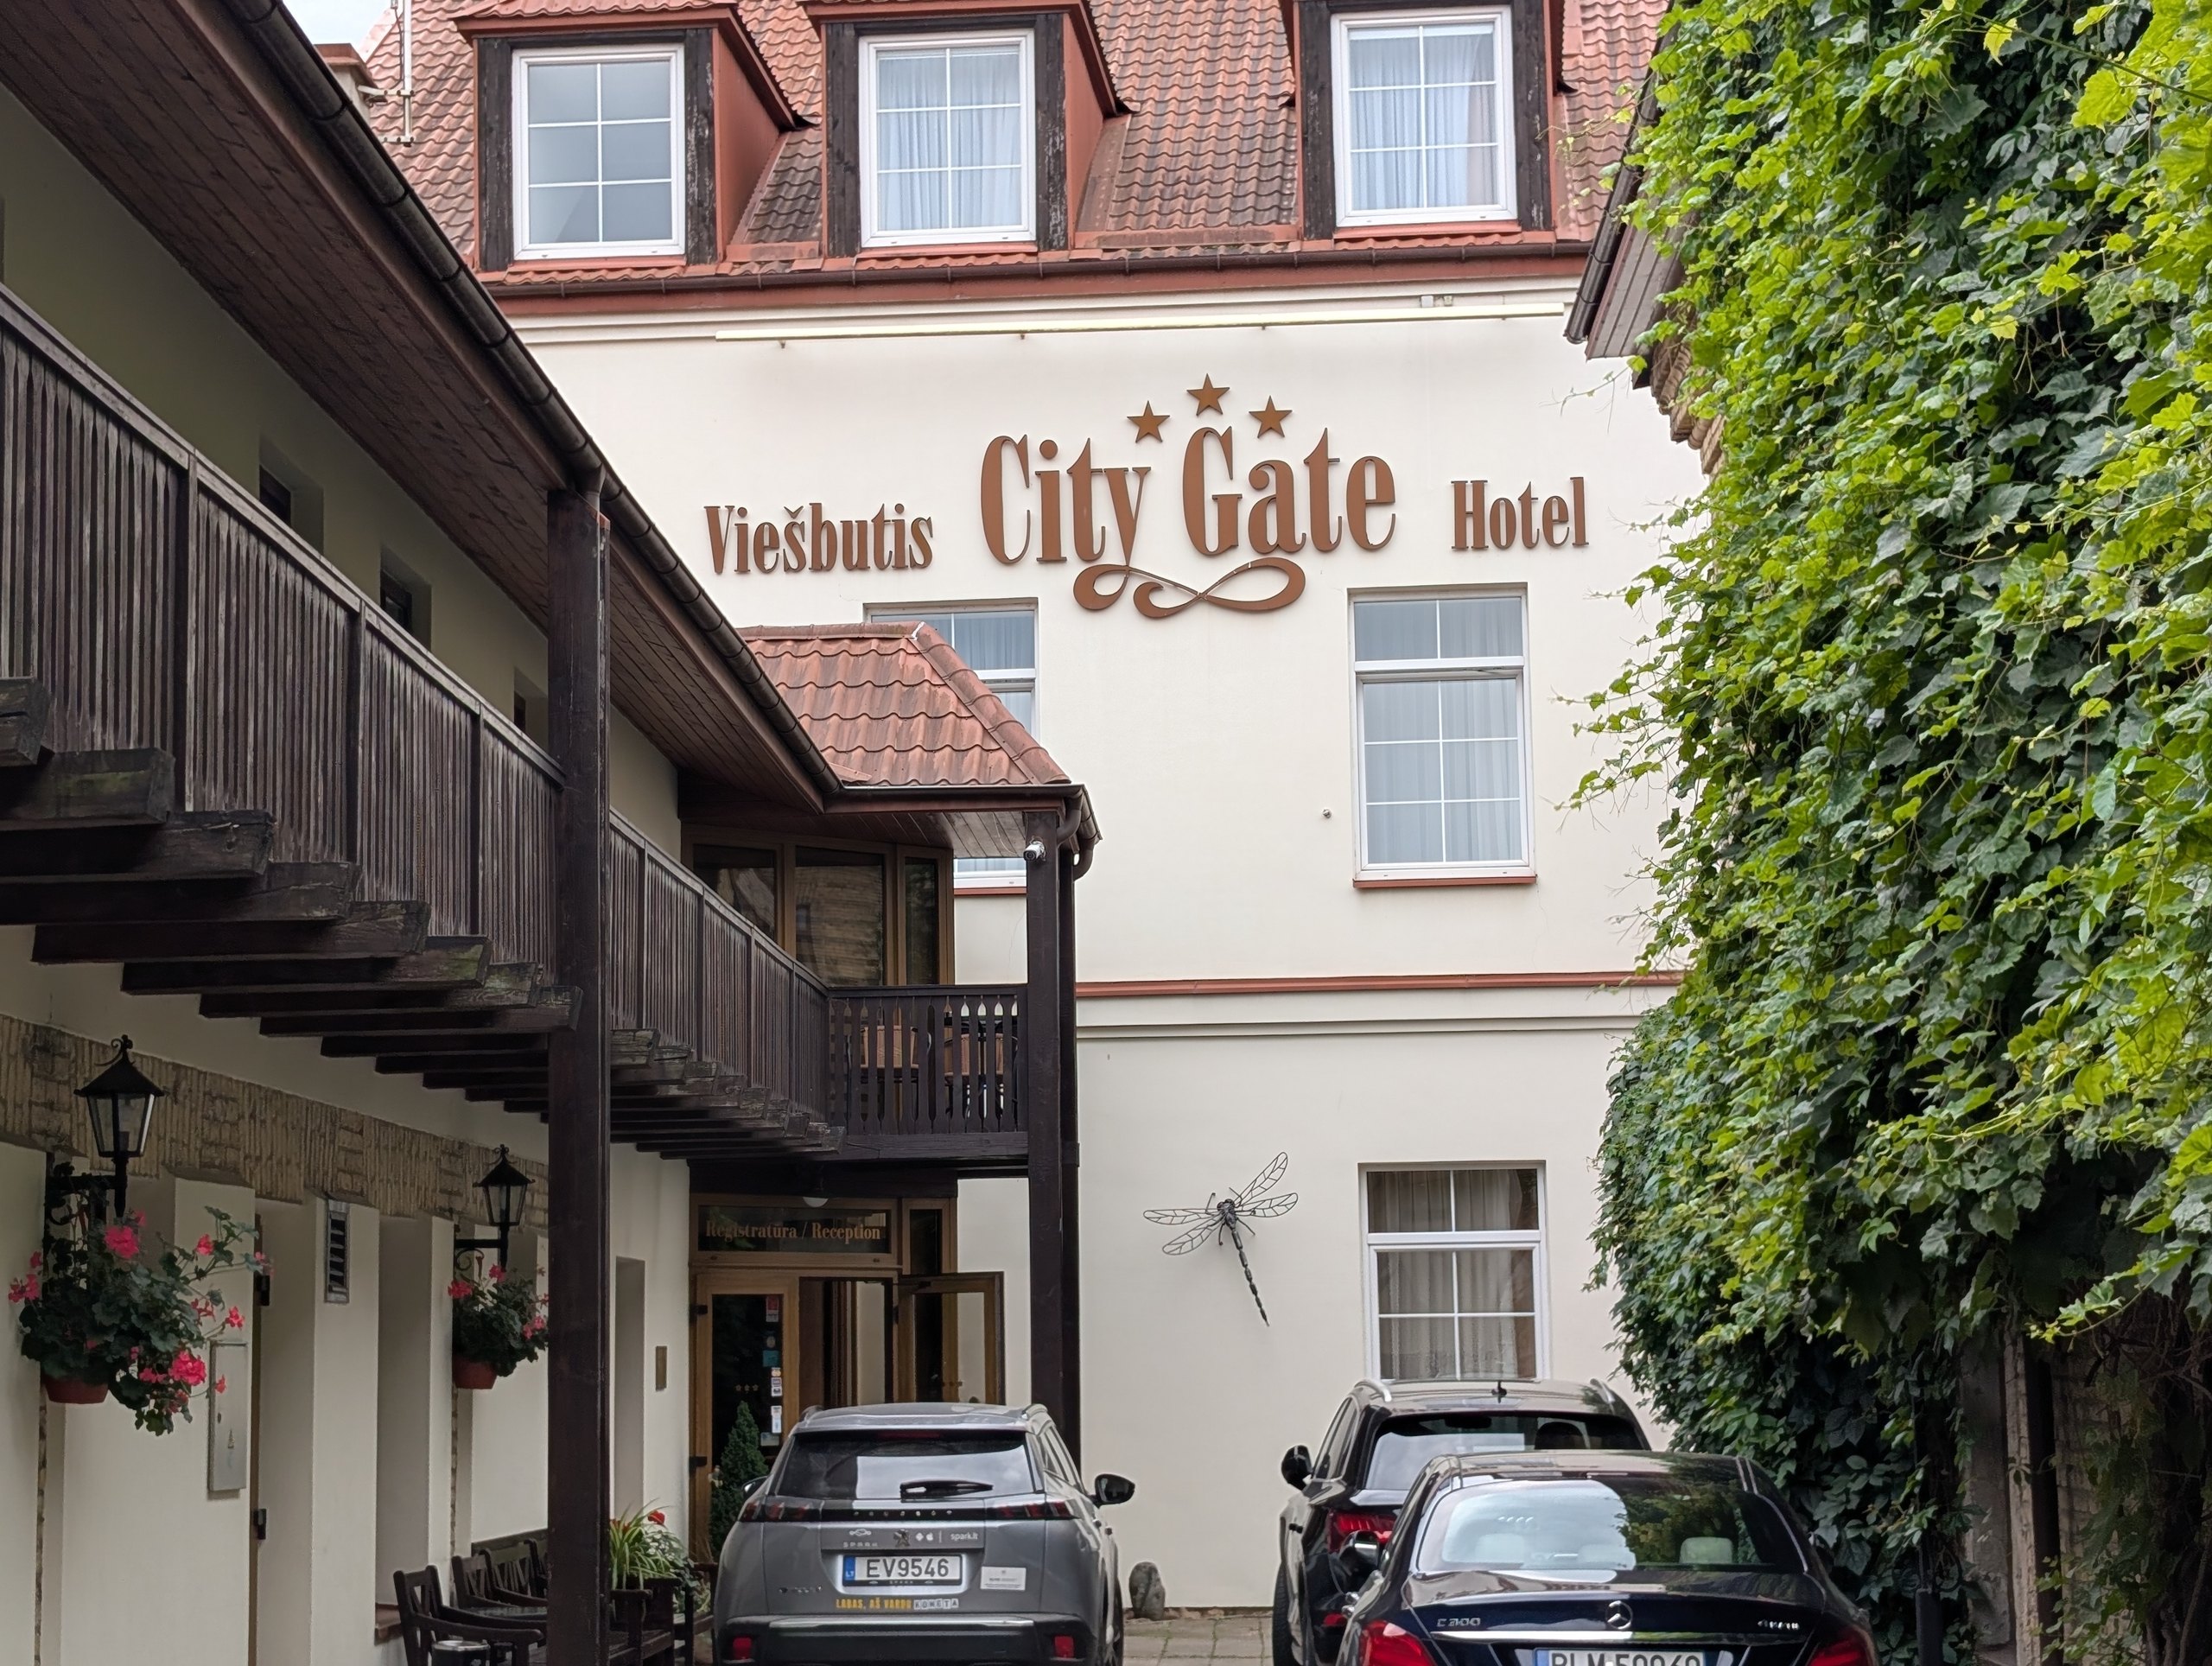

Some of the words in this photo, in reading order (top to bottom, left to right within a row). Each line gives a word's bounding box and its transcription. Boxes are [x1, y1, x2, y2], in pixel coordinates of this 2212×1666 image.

[704, 501, 933, 574] Viešbutis
[981, 435, 1152, 568] City
[1182, 426, 1395, 558] Gate
[1452, 477, 1589, 553] Hotel
[812, 1222, 880, 1245] Reception
[867, 1558, 950, 1579] EV9546
